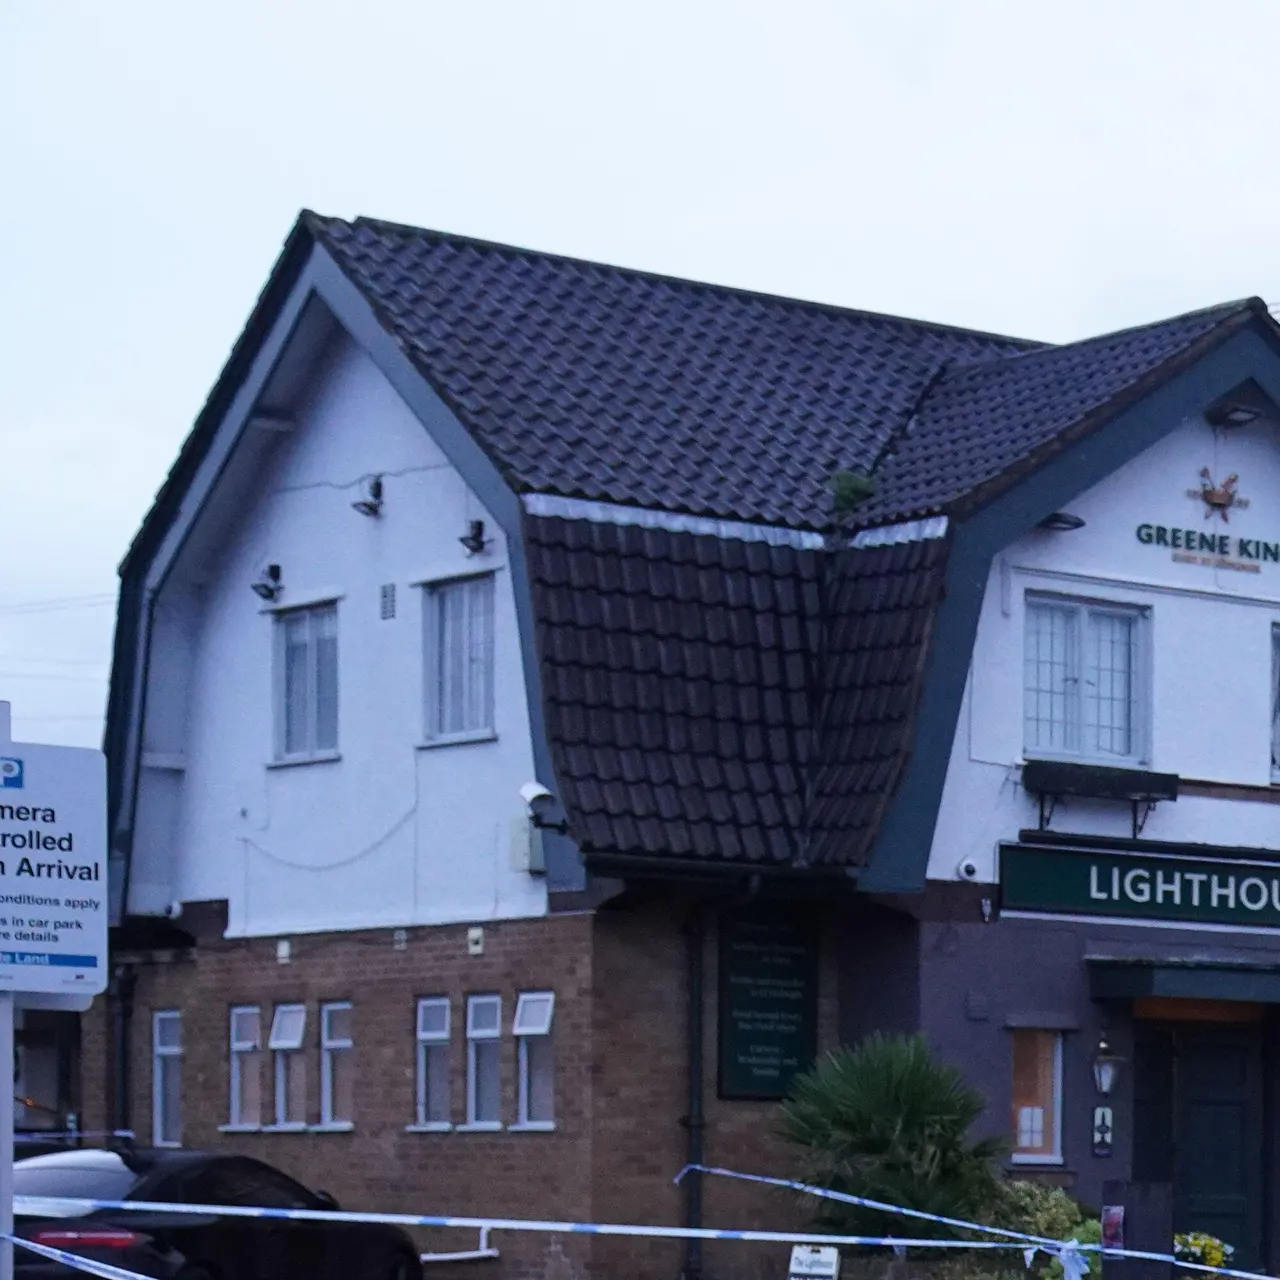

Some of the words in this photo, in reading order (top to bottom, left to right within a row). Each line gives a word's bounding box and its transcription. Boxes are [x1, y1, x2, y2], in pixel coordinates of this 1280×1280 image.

[1136, 523, 1230, 555] GREENE
[16, 858, 99, 882] Arrival
[64, 898, 101, 911] apply
[12, 917, 24, 927] in
[28, 918, 50, 928] car
[53, 919, 83, 930] park
[14, 932, 59, 943] details
